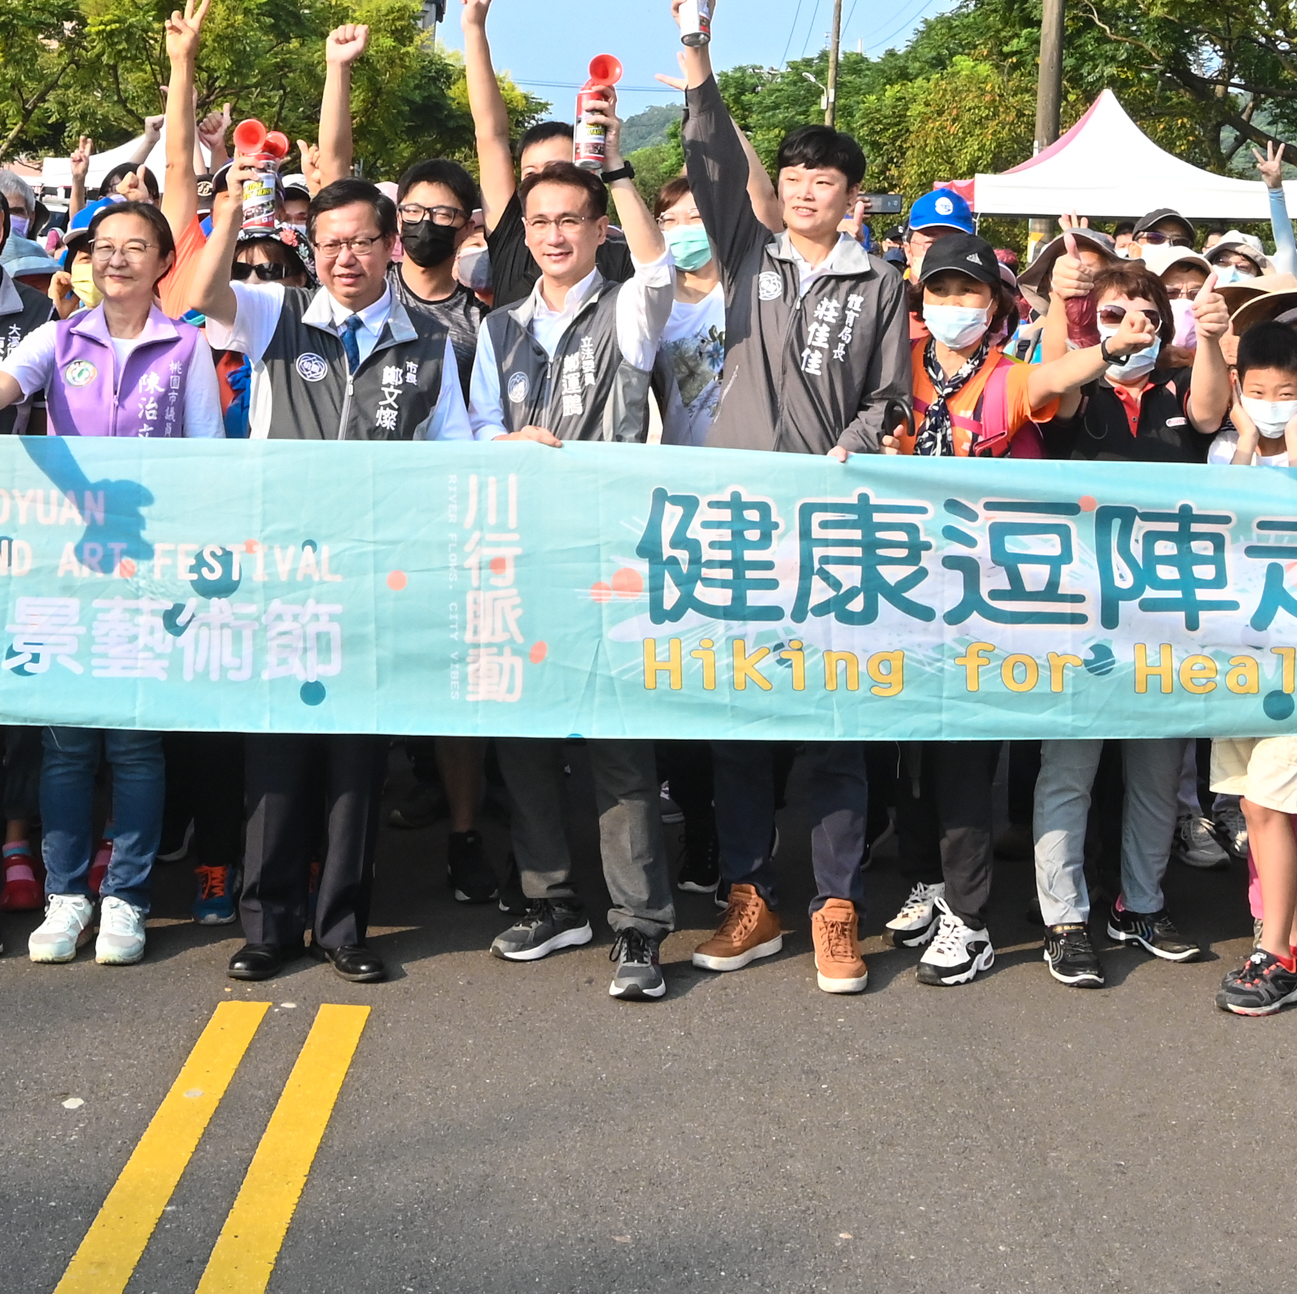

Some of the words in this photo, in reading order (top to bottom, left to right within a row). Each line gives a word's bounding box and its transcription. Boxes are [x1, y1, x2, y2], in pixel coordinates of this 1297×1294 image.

[7, 324, 22, 356] 大溪
[581, 336, 597, 386] 立法委員
[800, 297, 841, 376] 莊佳佳
[375, 365, 403, 431] 鄭文燦
[405, 361, 419, 386] 市長
[562, 352, 584, 417] 鄭運鵬
[447, 474, 458, 524] RIVER
[57, 542, 128, 579] ART
[154, 542, 343, 582] FESTIVAL
[464, 473, 524, 703] 川行脈動
[449, 602, 459, 641] CITY
[449, 651, 460, 700] VIBES
[643, 638, 904, 697] Hiking
[955, 641, 1083, 693] for
